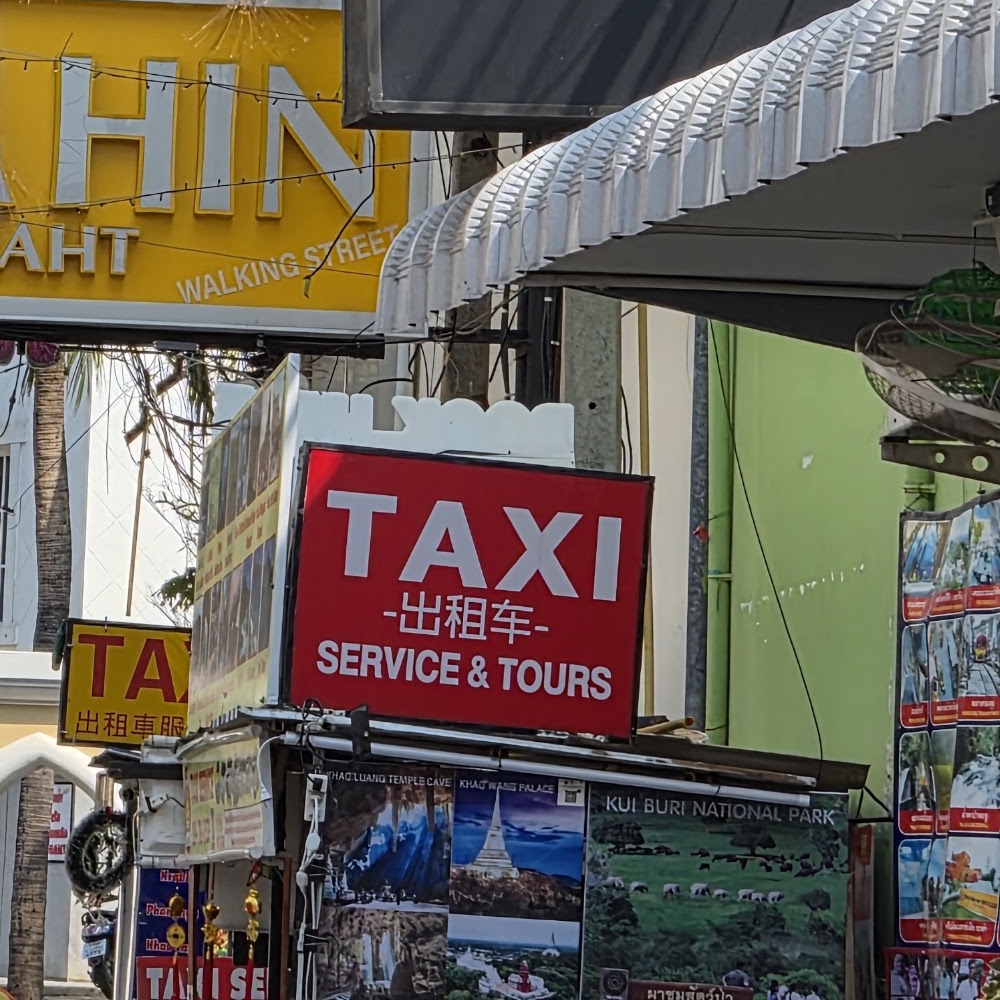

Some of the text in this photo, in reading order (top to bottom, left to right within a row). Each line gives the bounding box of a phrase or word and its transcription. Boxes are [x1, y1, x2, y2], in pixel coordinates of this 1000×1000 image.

[51, 54, 380, 222] HIN
[176, 253, 300, 304] WALKING
[326, 489, 622, 602] TAXI
[78, 633, 191, 704] TA
[317, 640, 459, 686] SERVICE
[467, 656, 488, 689] &
[498, 657, 612, 701] TOURS
[353, 772, 387, 784] LUANG
[389, 774, 425, 786] TEMPLE
[427, 777, 453, 787] CAVE
[459, 779, 486, 790] KHAO
[518, 783, 554, 794] PALACE
[606, 796, 835, 826] KUI BURI NATIONAL PARK
[146, 968, 219, 1000] TAI
